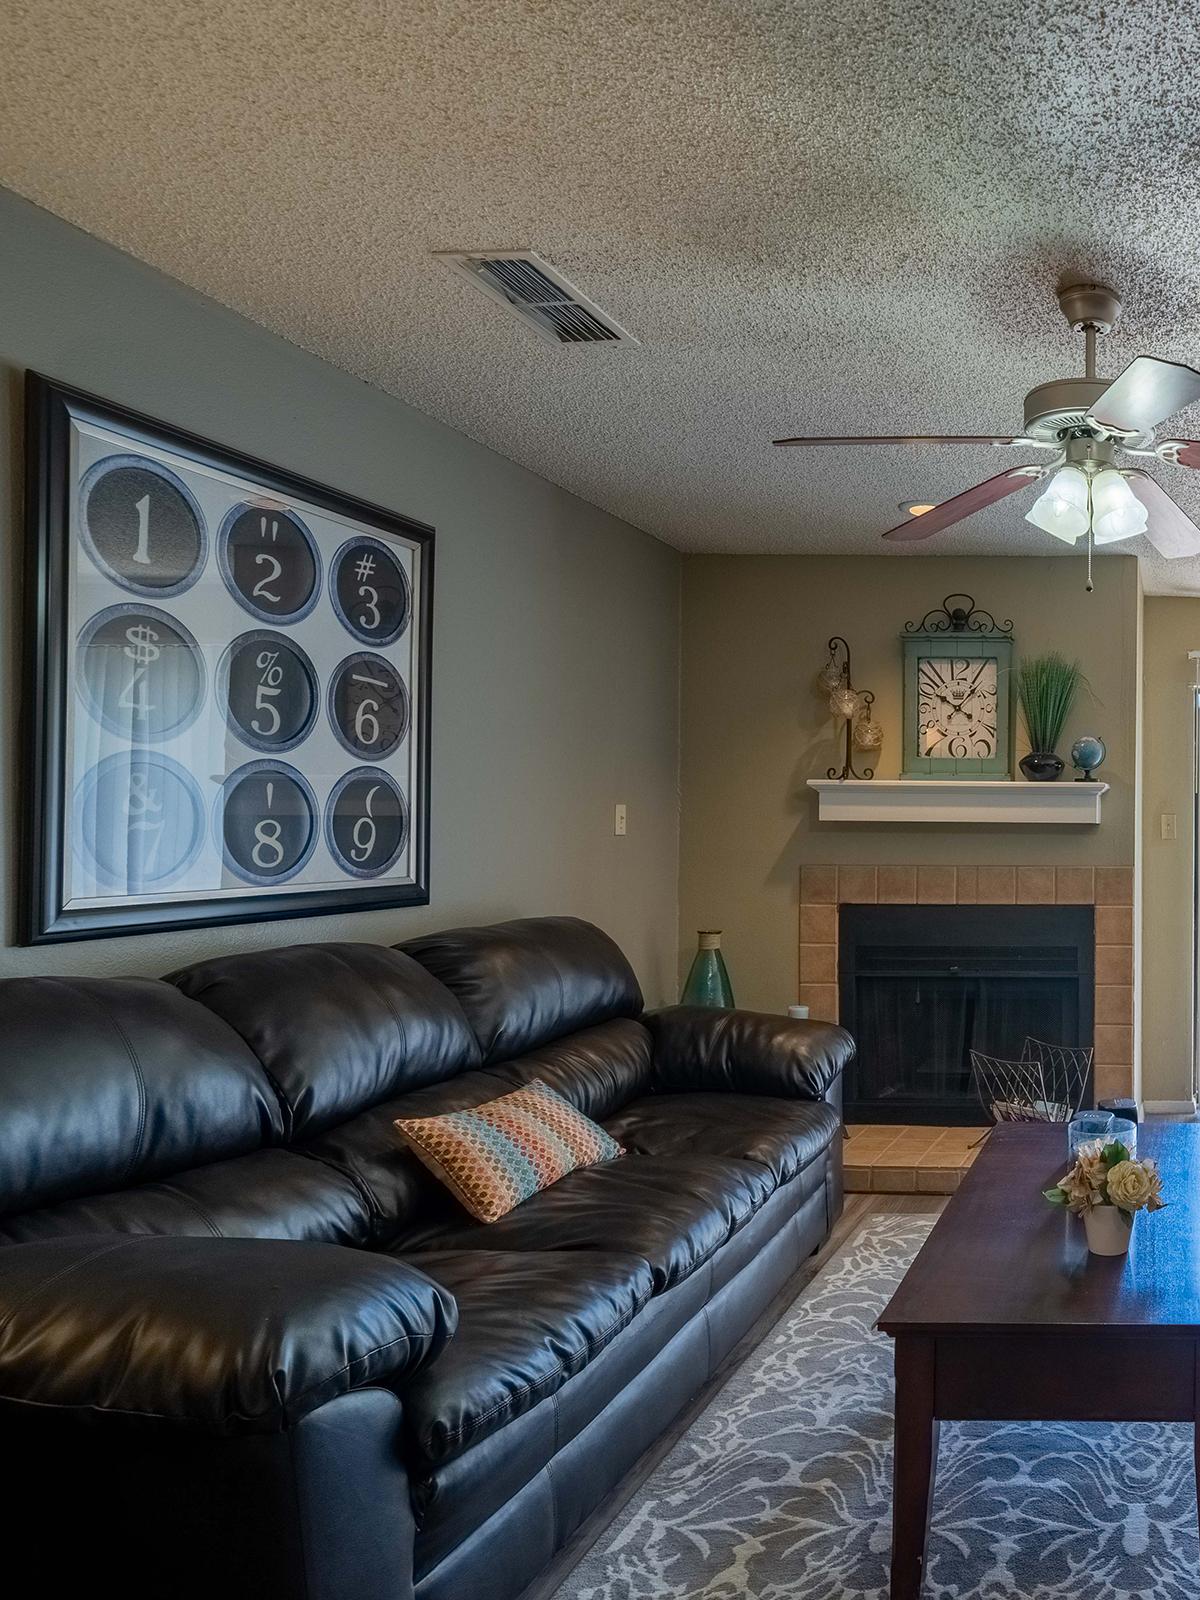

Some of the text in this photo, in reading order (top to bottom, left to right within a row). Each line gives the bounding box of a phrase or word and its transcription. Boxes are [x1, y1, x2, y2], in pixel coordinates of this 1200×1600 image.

[132, 494, 151, 564] 1
[252, 553, 282, 602] 2
[354, 553, 376, 582] #
[358, 585, 381, 629] 3
[123, 624, 160, 664] $
[256, 651, 283, 686] %
[949, 658, 970, 682] 12
[118, 667, 156, 720] 4
[919, 682, 936, 700] 10
[919, 702, 932, 715] 9
[251, 684, 281, 736] 5
[355, 699, 380, 745] 6
[919, 719, 936, 736] 8
[924, 728, 948, 757] 7
[947, 736, 968, 759] 6
[968, 730, 992, 759] 5
[251, 819, 284, 868] 8
[350, 817, 377, 862] 9
